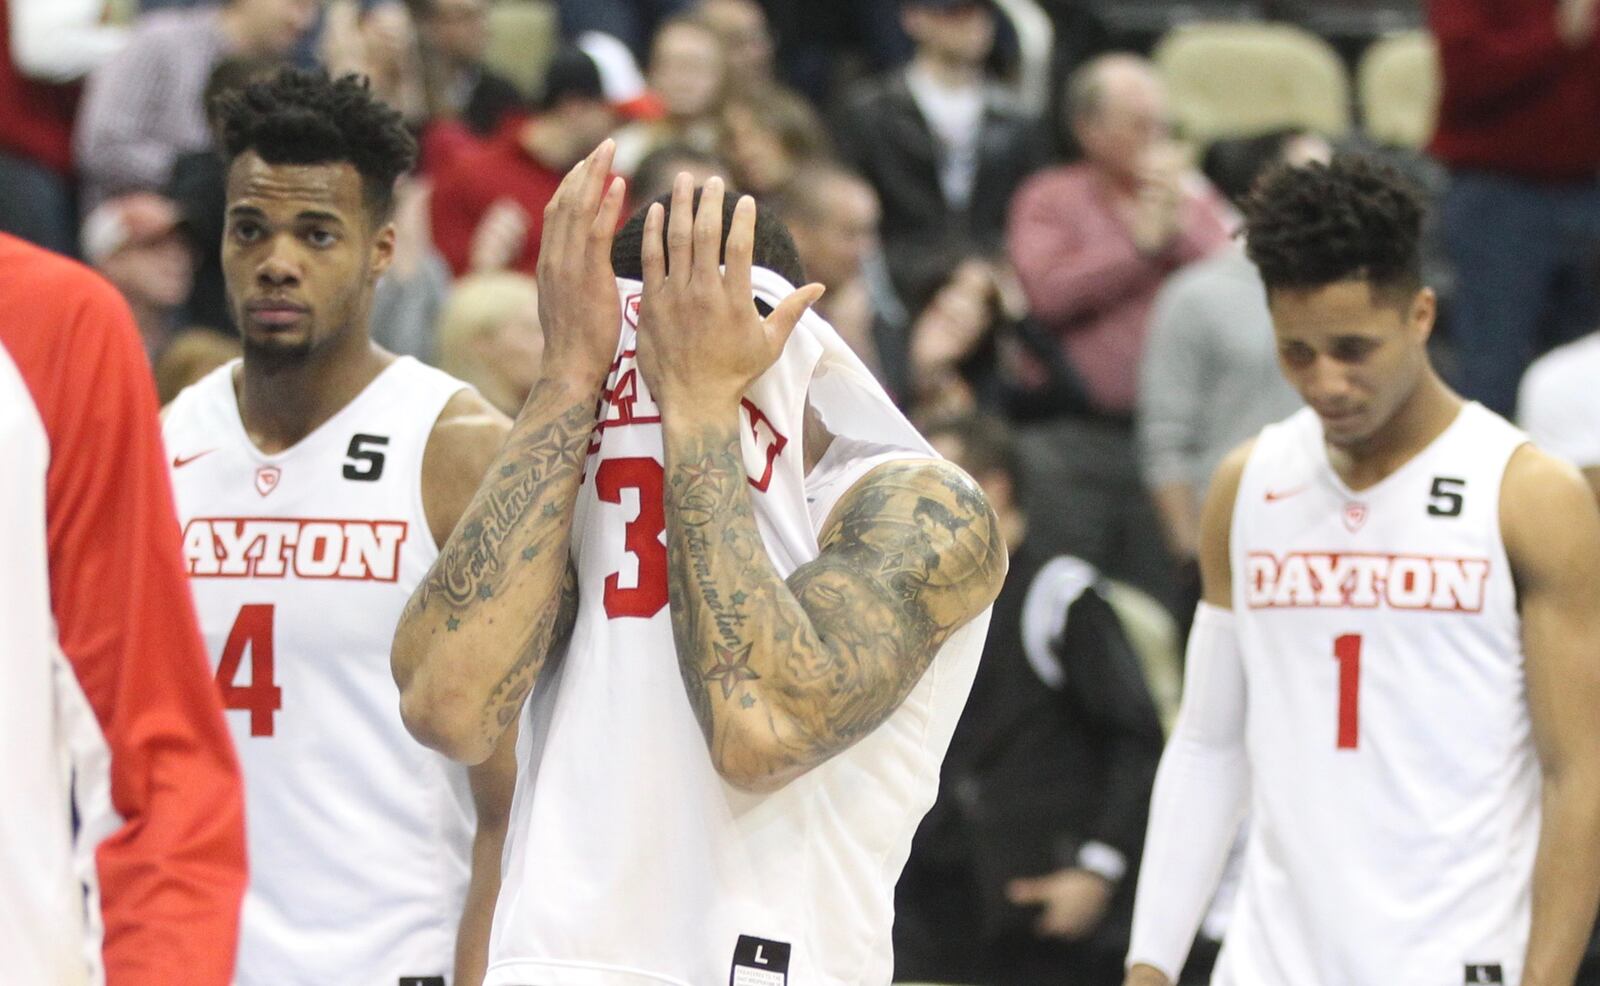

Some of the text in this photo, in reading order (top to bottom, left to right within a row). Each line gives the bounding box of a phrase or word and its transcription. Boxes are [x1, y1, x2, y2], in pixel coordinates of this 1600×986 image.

[342, 433, 390, 482] 5
[1426, 477, 1465, 517] 5
[182, 517, 408, 583] AYTON
[595, 457, 669, 619] 3
[1247, 551, 1490, 614] DAYTON
[214, 603, 282, 738] 4
[1333, 633, 1363, 750] 1
[754, 944, 769, 965] L
